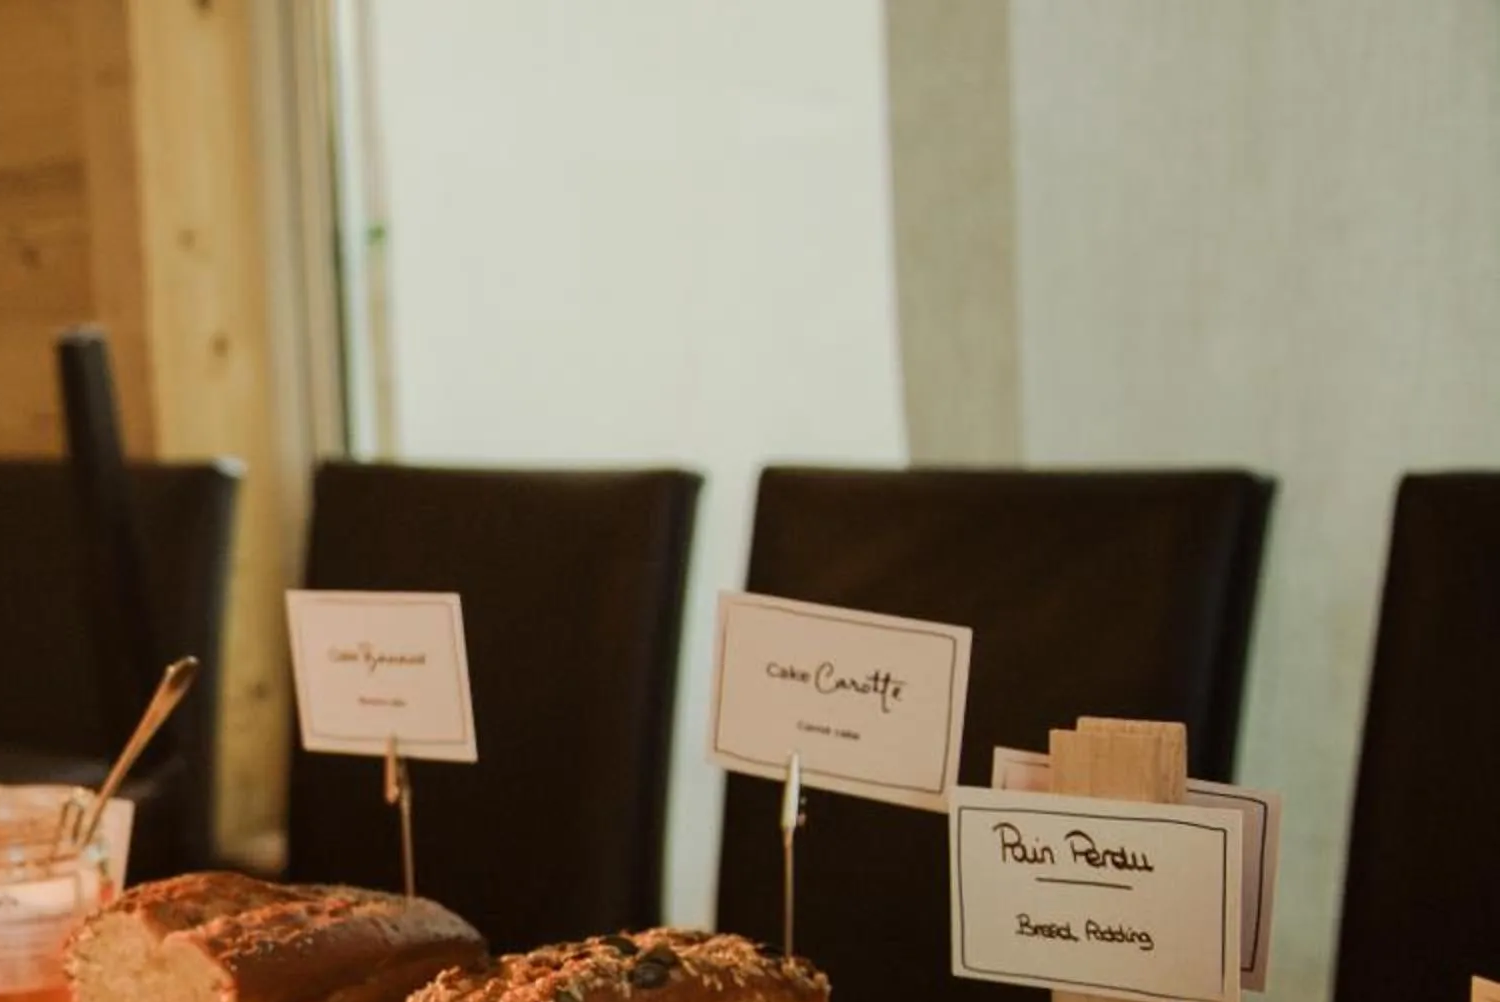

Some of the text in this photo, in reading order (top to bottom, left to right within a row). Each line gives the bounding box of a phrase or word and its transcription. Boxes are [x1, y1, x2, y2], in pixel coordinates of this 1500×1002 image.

[993, 822, 1153, 872] Pain Perdu
[1015, 913, 1079, 942] Bread
